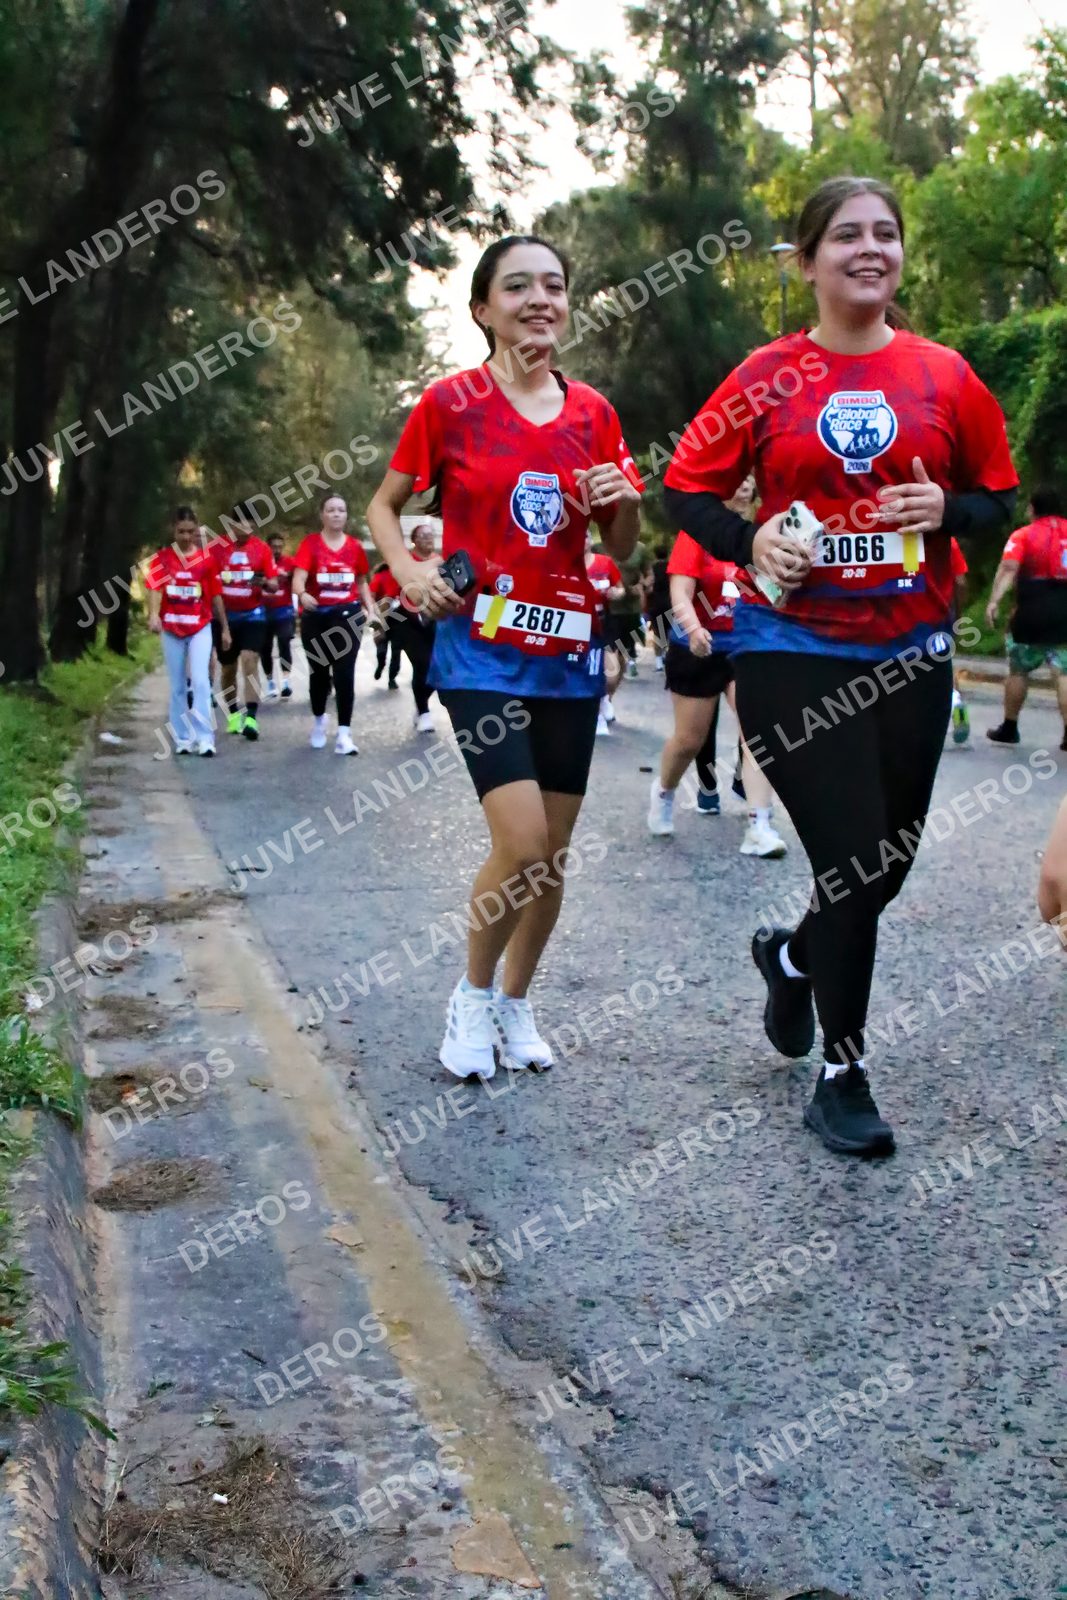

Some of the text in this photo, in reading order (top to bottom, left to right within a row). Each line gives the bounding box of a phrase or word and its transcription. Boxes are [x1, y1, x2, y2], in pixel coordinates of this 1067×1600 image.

[837, 397, 877, 405] BIMBO
[837, 408, 877, 420] Global
[830, 418, 863, 430] Race
[525, 478, 553, 488] BIMBO
[520, 500, 541, 512] Race
[822, 534, 885, 564] 3066
[841, 568, 867, 579] 20-26
[897, 578, 913, 588] 5K
[512, 603, 566, 635] 2687
